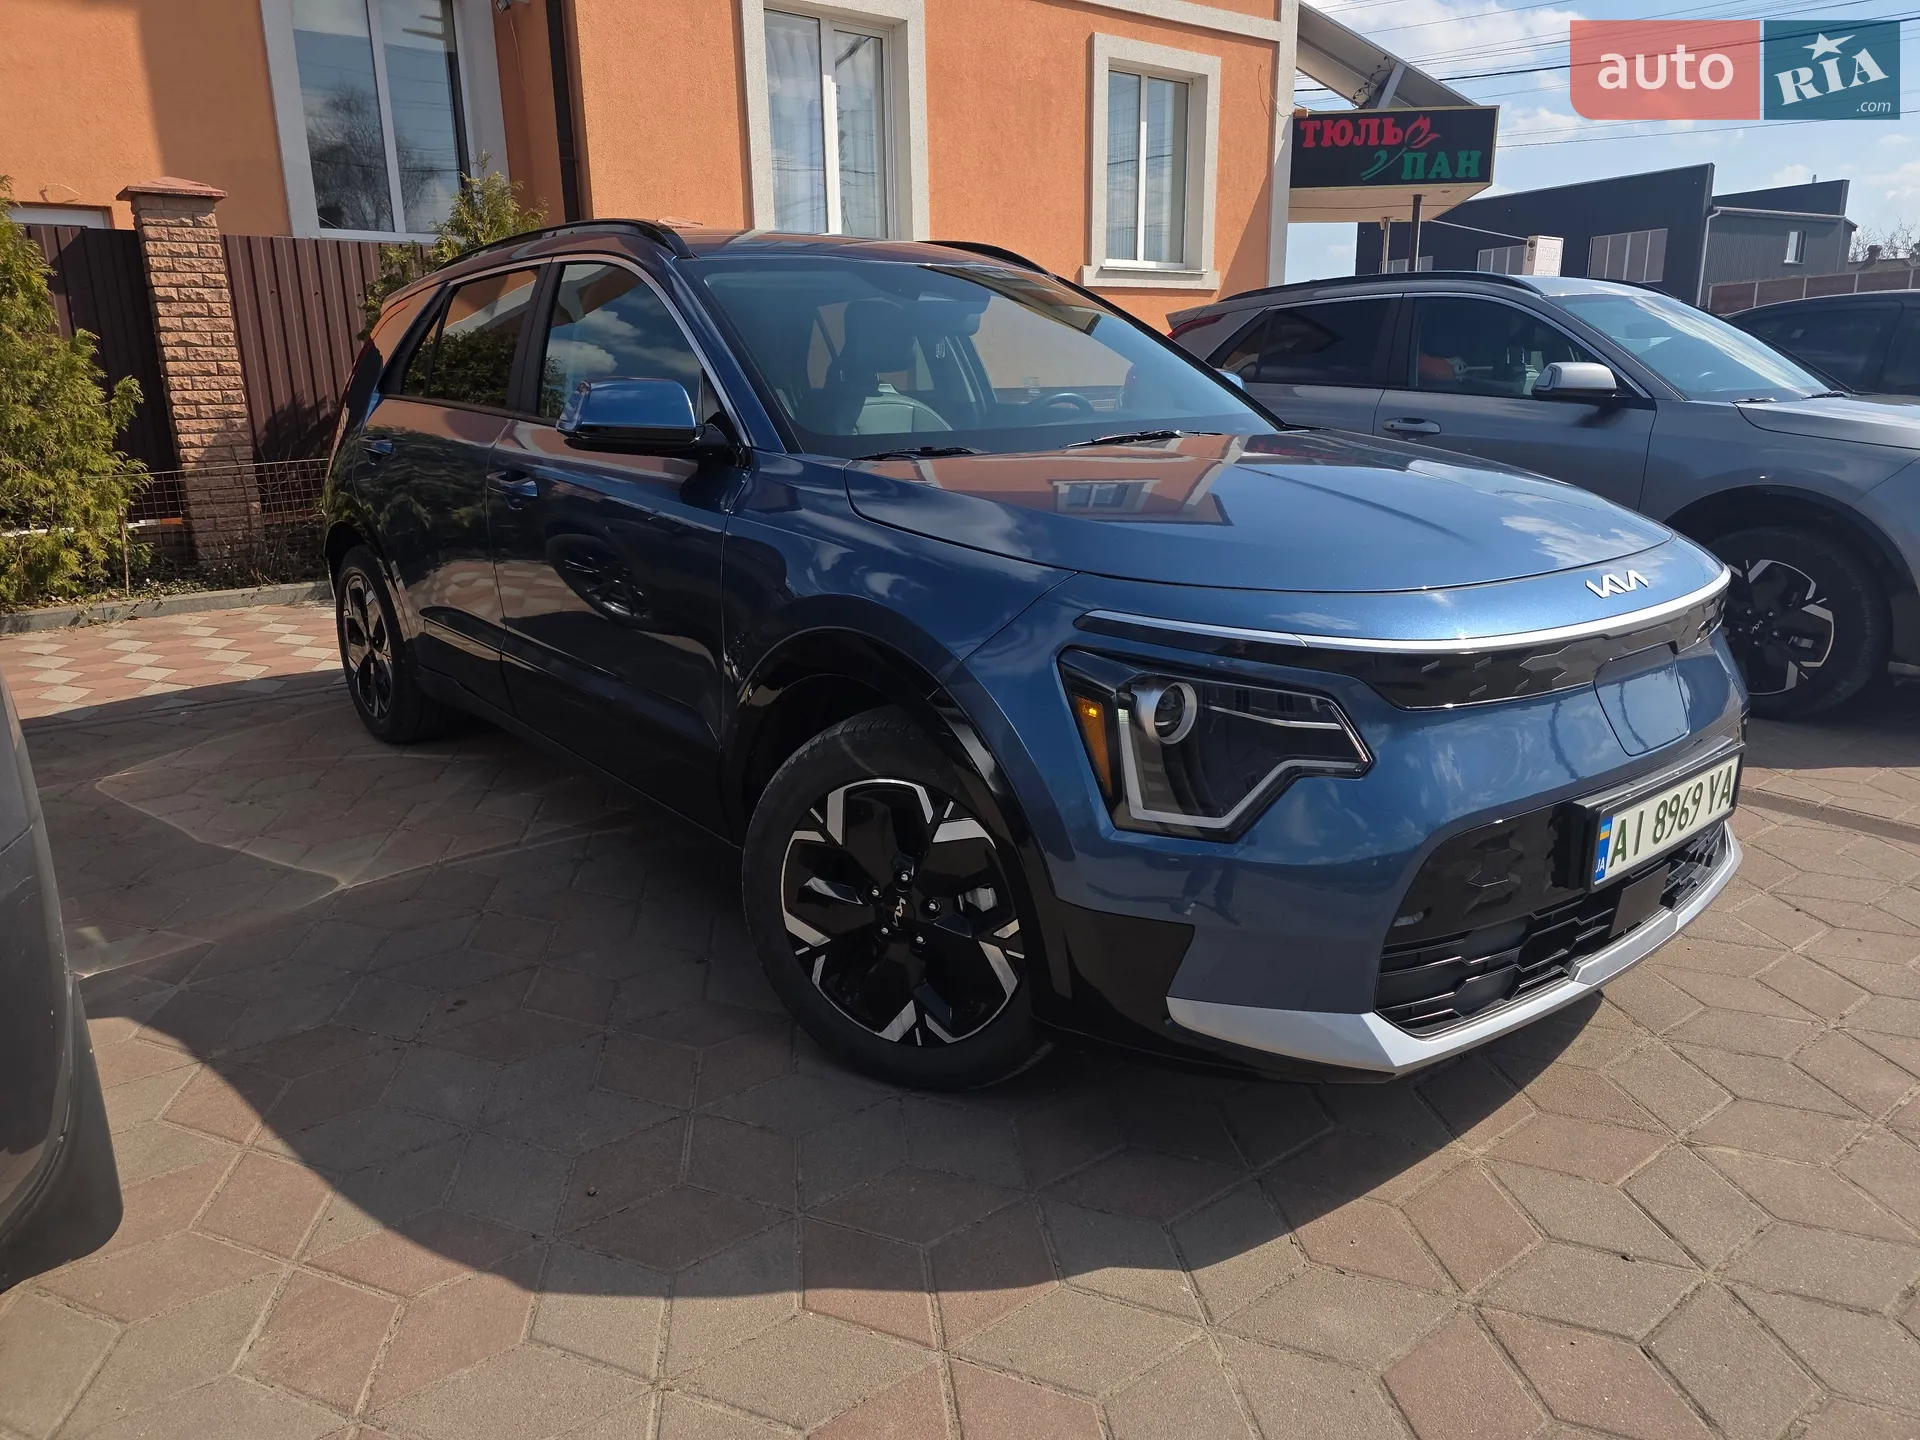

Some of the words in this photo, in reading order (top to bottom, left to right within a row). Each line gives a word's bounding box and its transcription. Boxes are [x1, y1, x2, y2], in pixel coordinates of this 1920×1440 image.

[1300, 117, 1404, 148] ТЮЛЬ
[1400, 150, 1482, 180] ПАН
[1585, 569, 1649, 599] KIA
[1608, 811, 1645, 868] AI
[1652, 781, 1704, 845] 8969
[1707, 765, 1733, 815] YA
